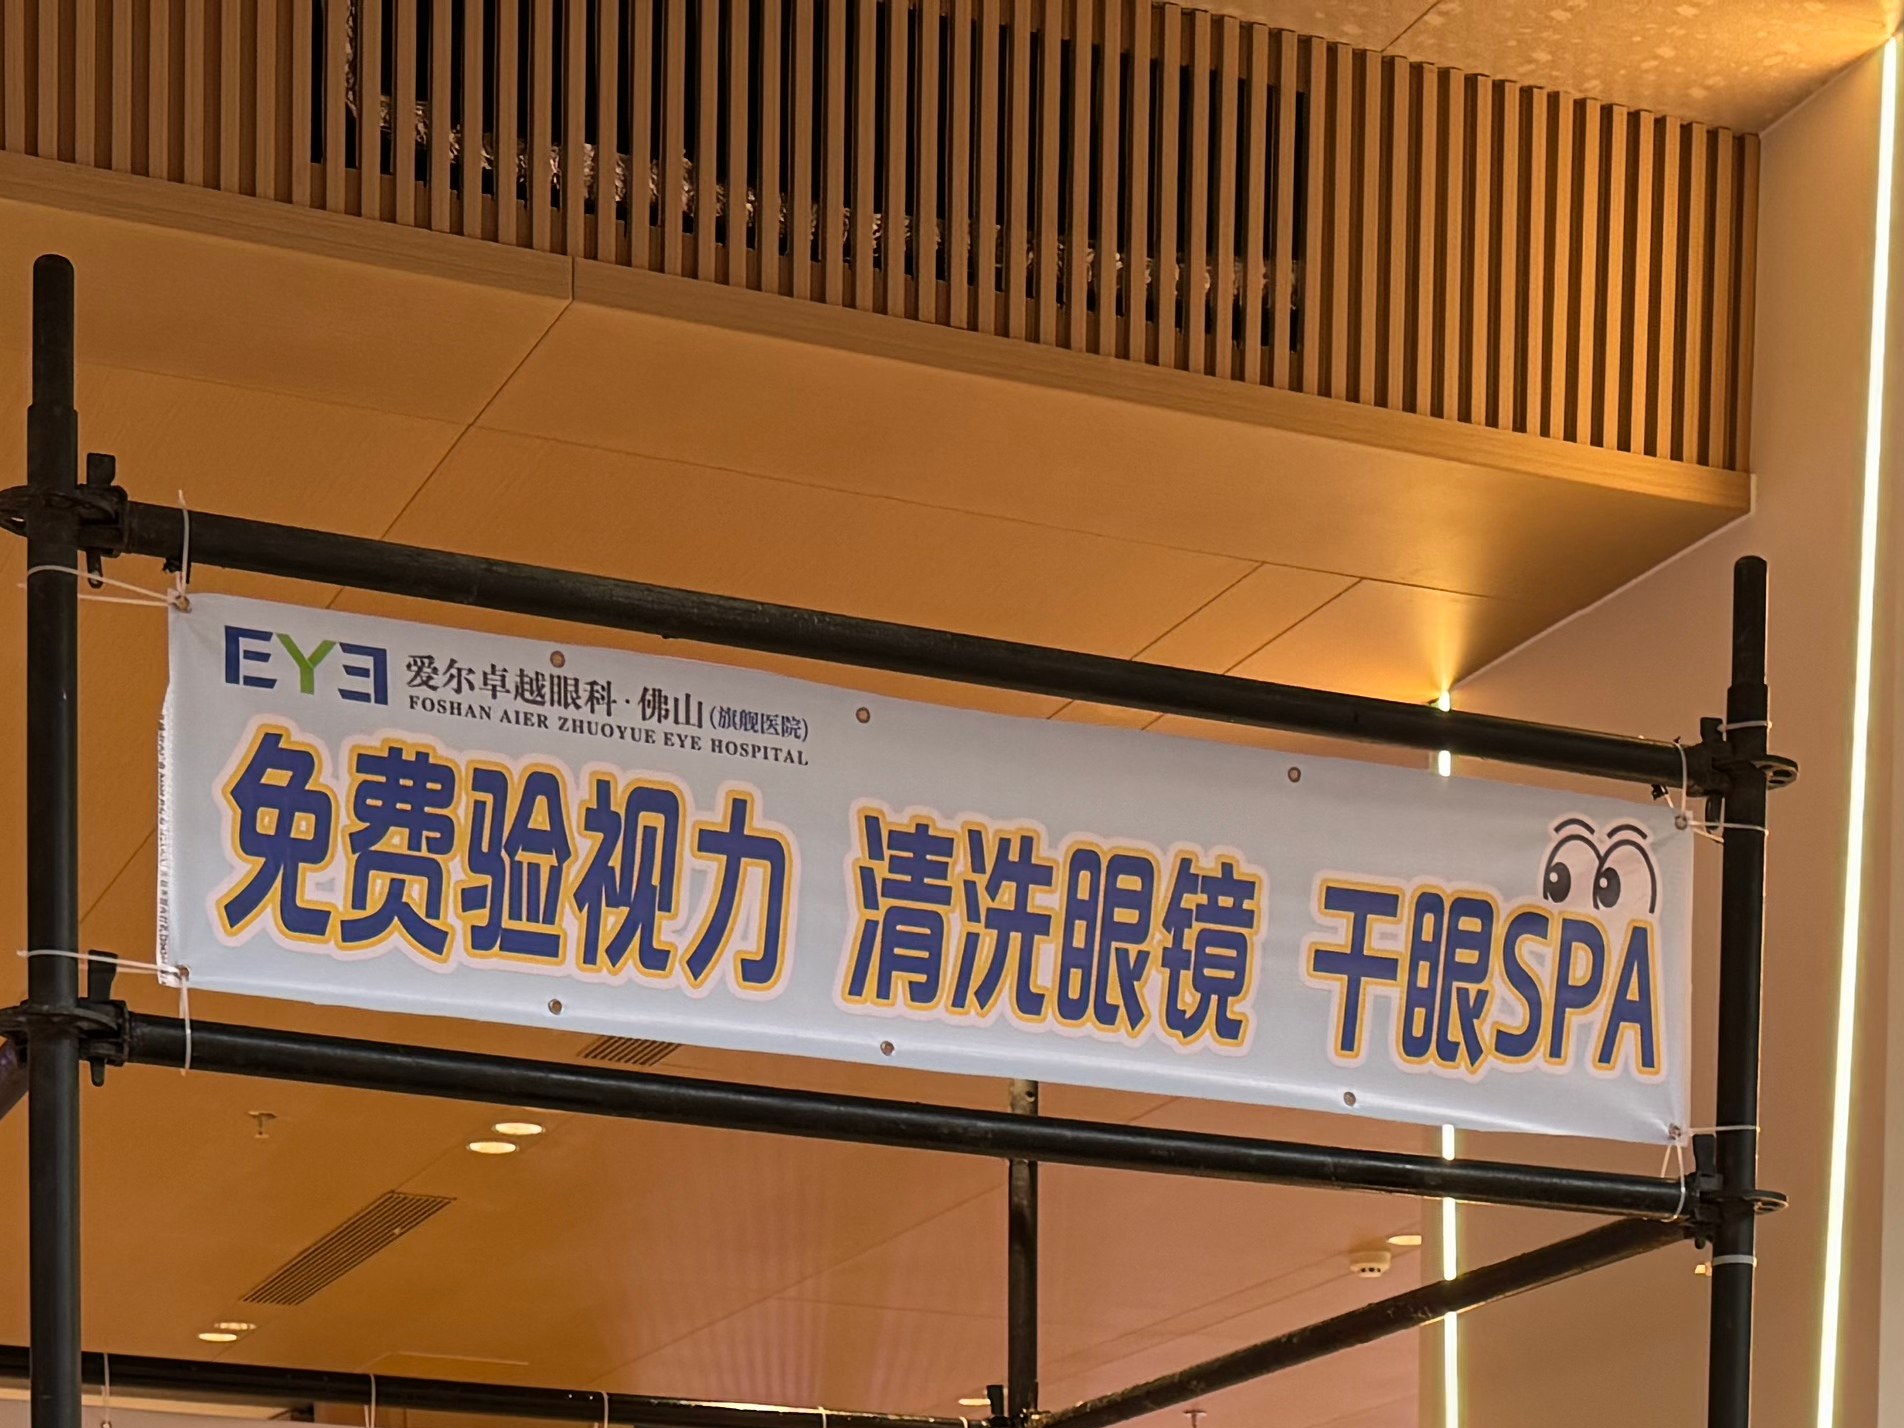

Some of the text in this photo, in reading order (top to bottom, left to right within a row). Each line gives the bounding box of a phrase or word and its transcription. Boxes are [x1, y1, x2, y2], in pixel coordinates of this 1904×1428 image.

[225, 625, 388, 706] EYE
[408, 695, 810, 766] FOSHAN AIER ZHUOYUE EYE HOSPITAL
[221, 731, 787, 986] 免费验视力
[843, 811, 1257, 1045] 清洗眼镜
[1310, 880, 1658, 1071] 干眼SPA
